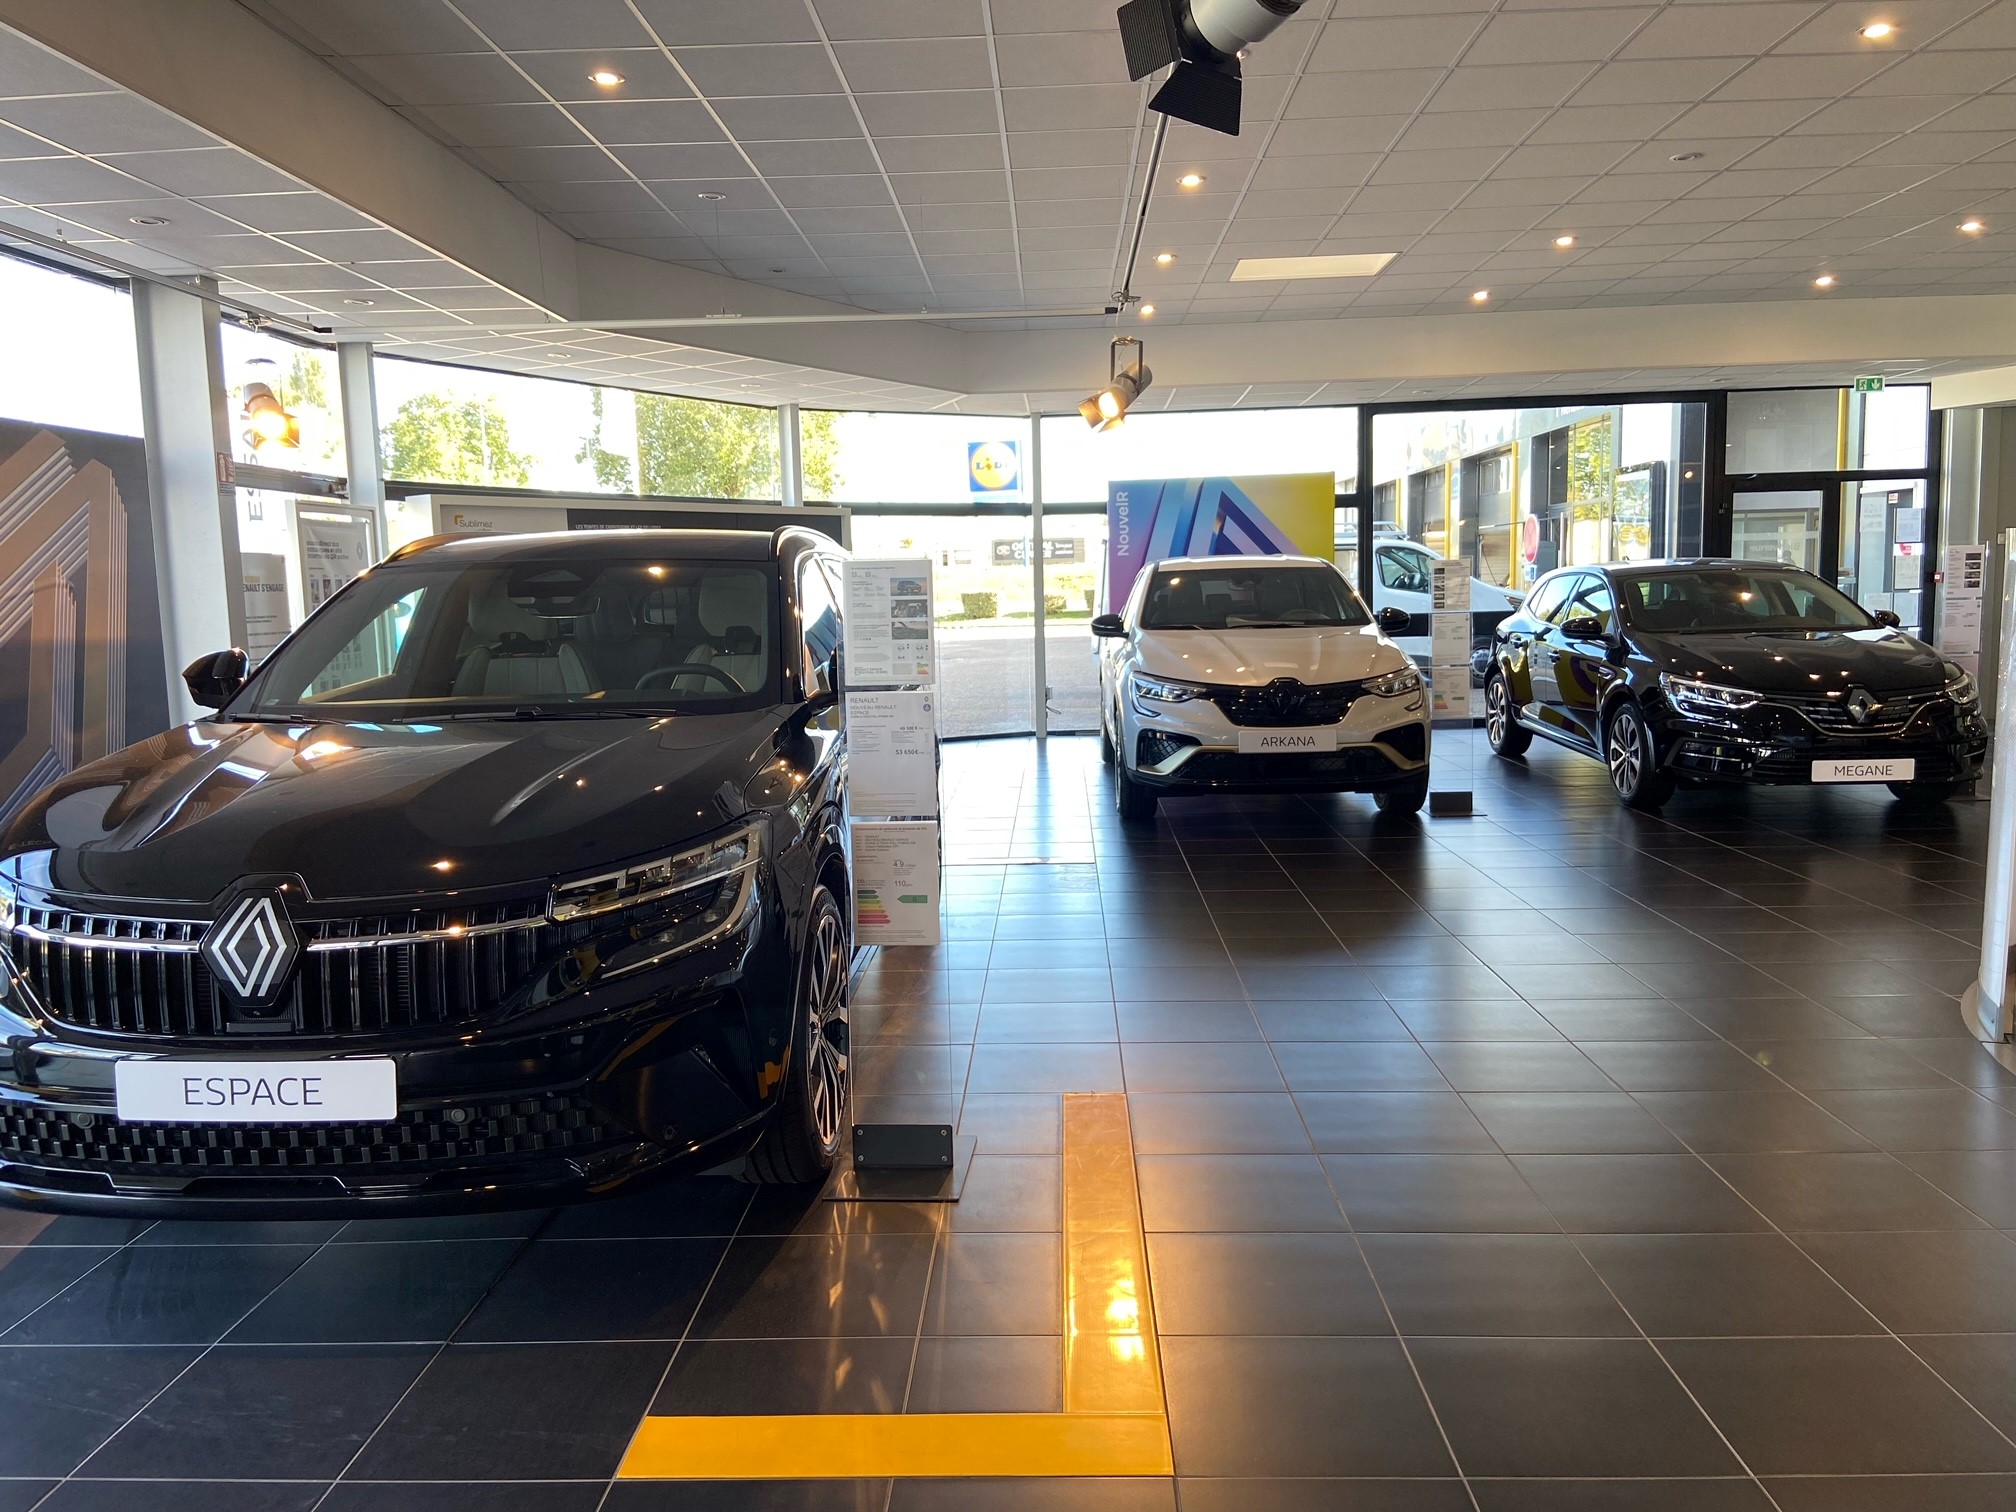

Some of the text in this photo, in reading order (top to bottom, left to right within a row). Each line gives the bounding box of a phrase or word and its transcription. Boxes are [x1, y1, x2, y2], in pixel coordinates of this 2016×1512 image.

[459, 519, 493, 528] Sublimez
[1116, 491, 1129, 556] NouvelR
[1260, 736, 1316, 748] ARKANA
[1834, 765, 1894, 777] MEGANE
[182, 1077, 323, 1106] ESPACE
